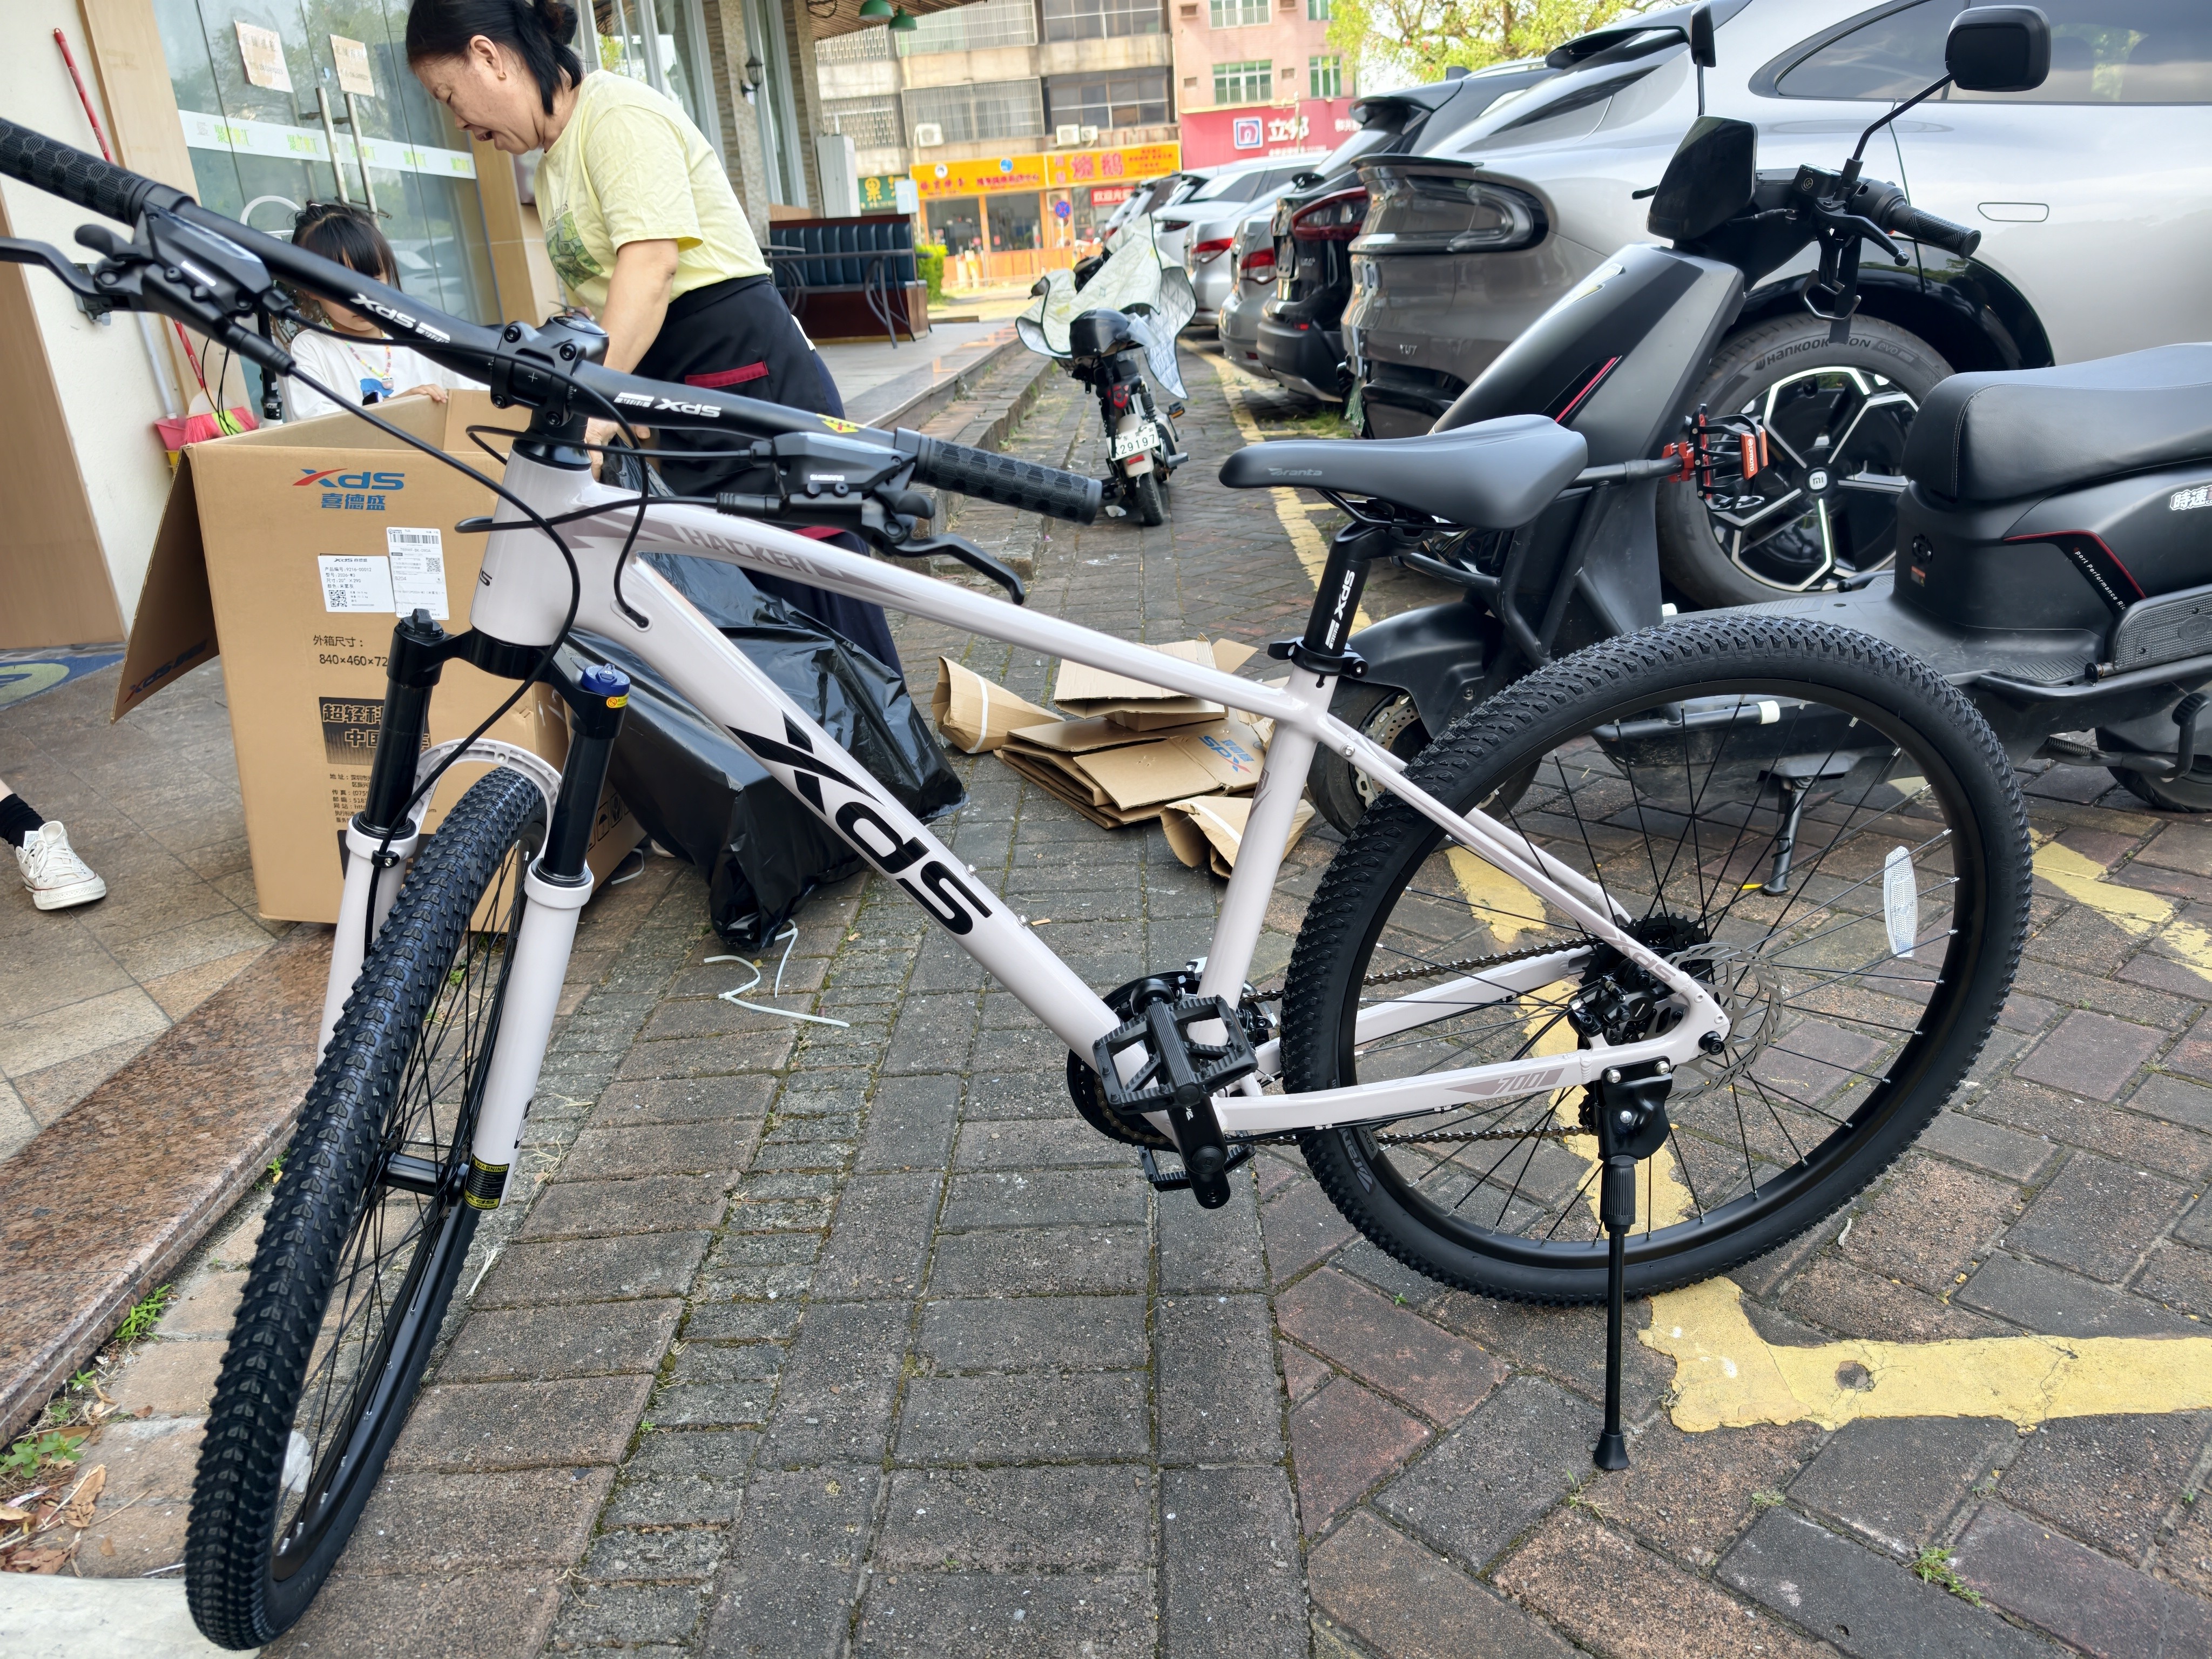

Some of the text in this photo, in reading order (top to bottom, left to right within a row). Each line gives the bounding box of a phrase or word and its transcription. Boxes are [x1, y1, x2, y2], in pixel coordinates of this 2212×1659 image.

[1115, 434, 1155, 456] 29197
[321, 493, 386, 510] 喜德盛
[680, 527, 812, 574] HACKER
[2087, 564, 2117, 600] Performance
[1495, 1071, 1546, 1095] 700
[477, 1162, 507, 1171] WARNING
